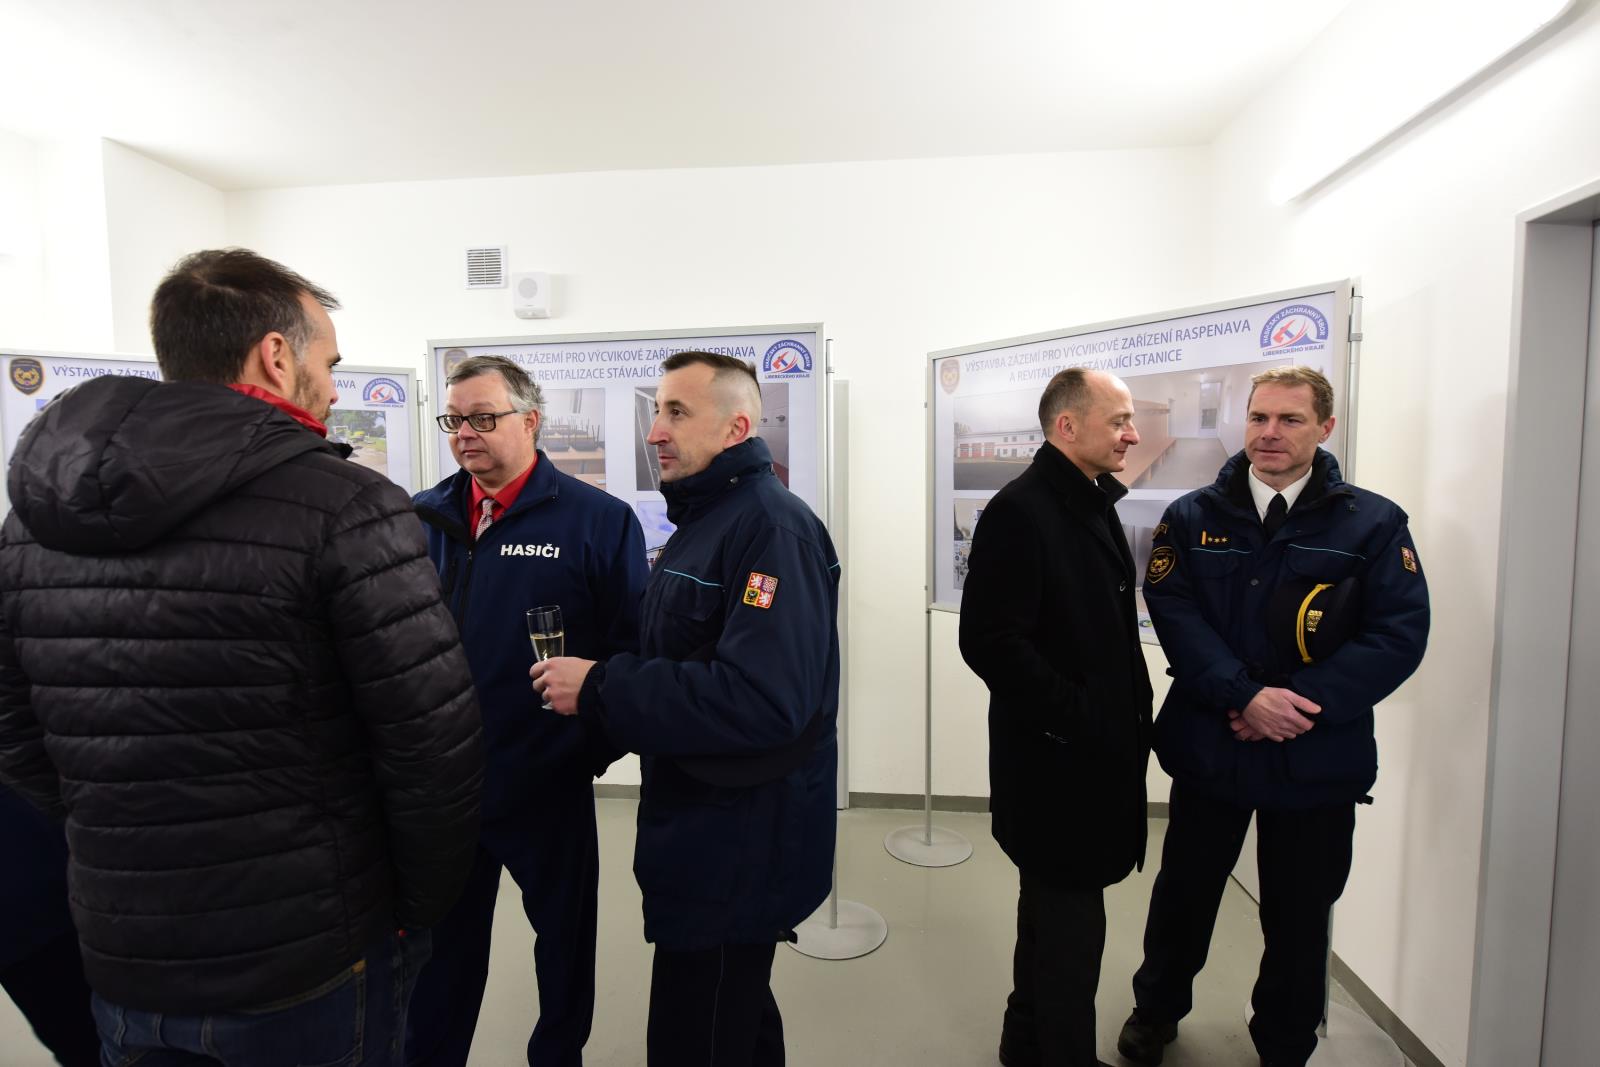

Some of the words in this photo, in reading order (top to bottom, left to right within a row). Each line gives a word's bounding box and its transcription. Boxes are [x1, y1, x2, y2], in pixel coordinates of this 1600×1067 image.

[965, 358, 1006, 373] VÝSTAVBA
[1007, 351, 1041, 366] ZÁZEMÍ
[1042, 348, 1062, 361] PRO
[1063, 338, 1119, 358] VÝCVIKOVÉ
[1121, 328, 1173, 350] ZAŘÍZENÍ
[1175, 319, 1251, 342] RASPENAVA
[527, 351, 564, 364] ZÁZEMÍ
[566, 351, 586, 363] PRO
[587, 349, 643, 364] VÝCVIKOVÉ
[52, 364, 113, 377] VÝSTAVBA
[539, 367, 604, 381] REVITALIZACE
[607, 366, 656, 379] STÁVAJÍCÍ
[1009, 372, 1016, 383] A
[1134, 349, 1182, 367] STANICE
[500, 543, 560, 558] HASIČI
